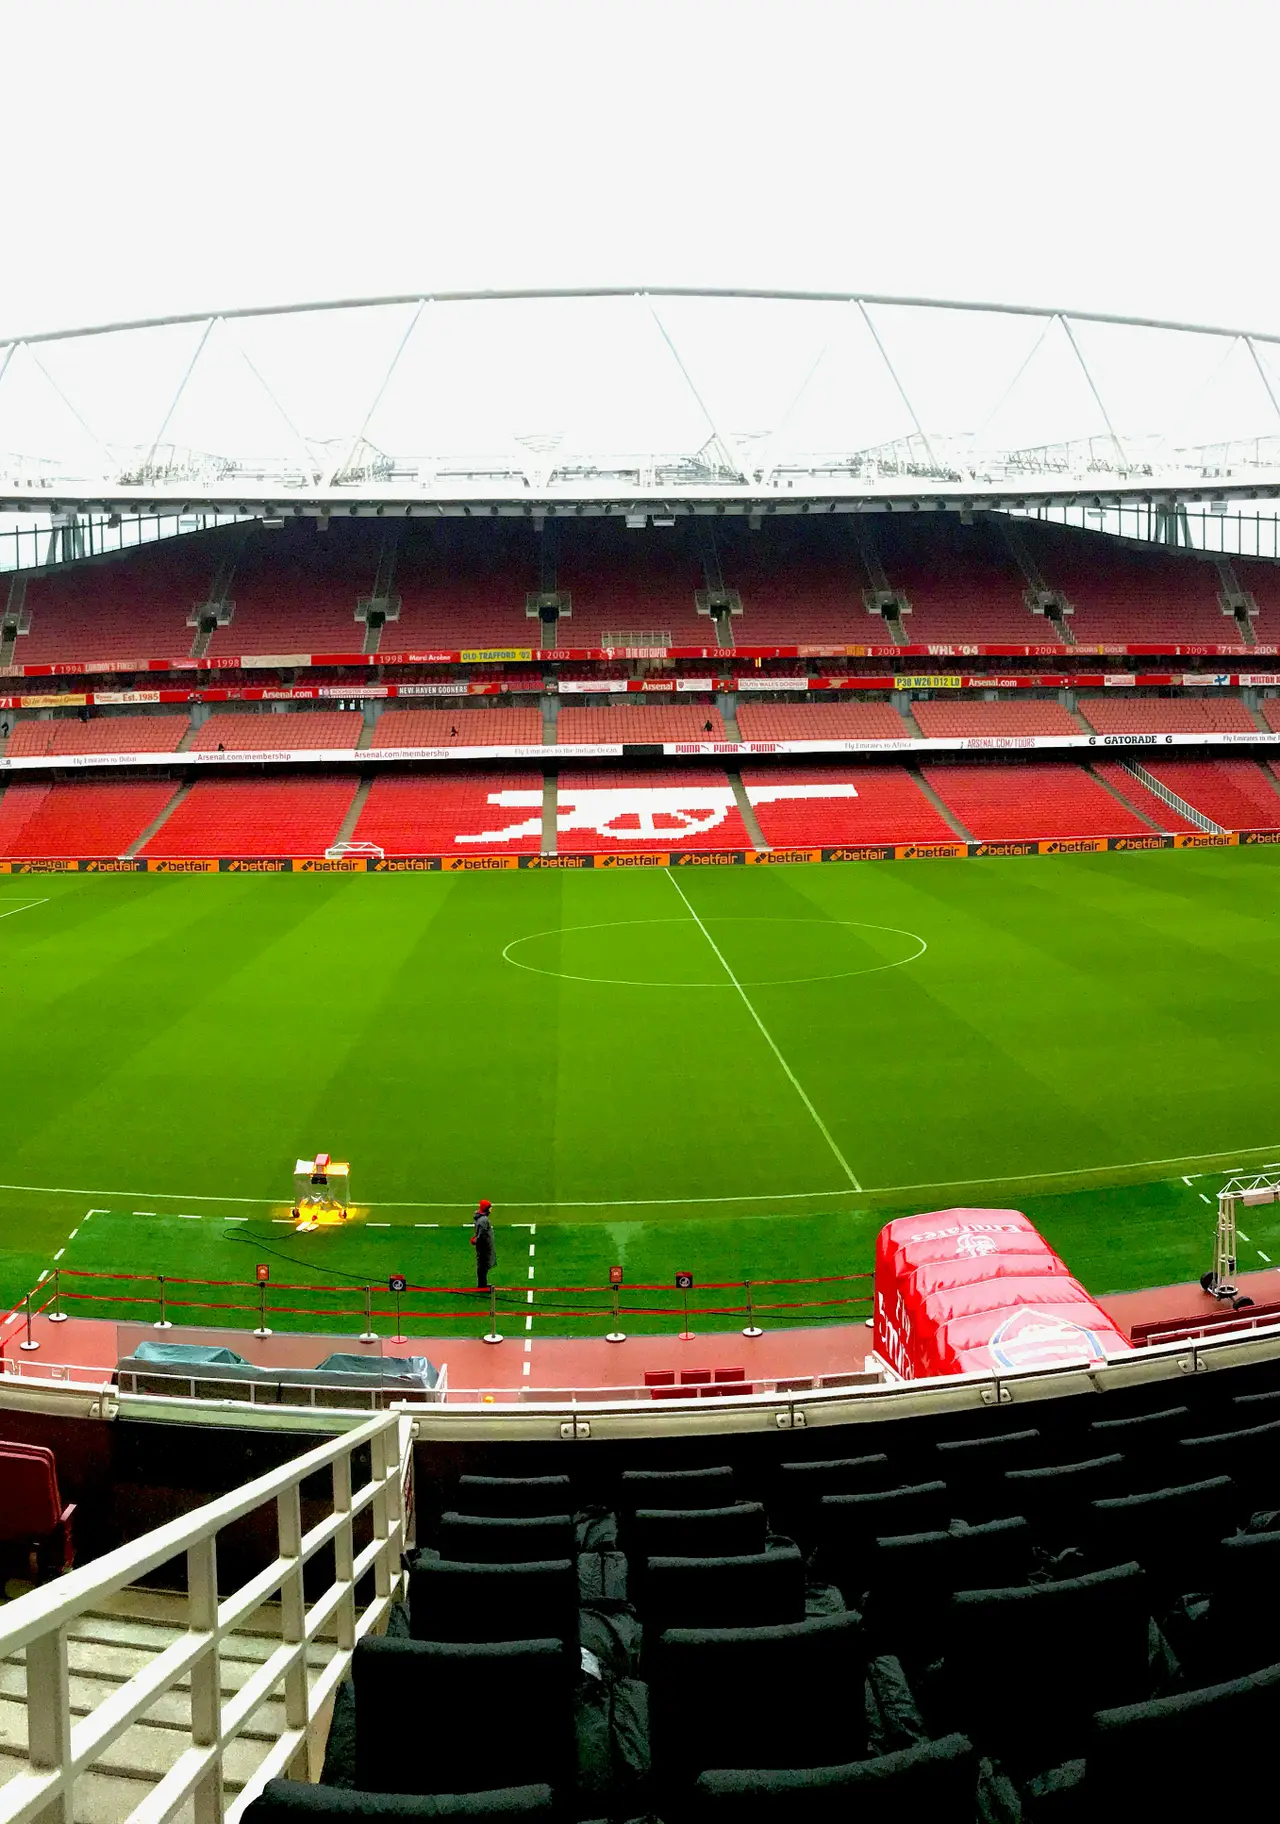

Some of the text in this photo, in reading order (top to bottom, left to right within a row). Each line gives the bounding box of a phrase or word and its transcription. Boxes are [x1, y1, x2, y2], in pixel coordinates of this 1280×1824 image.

[547, 651, 570, 659] 2002
[713, 648, 737, 657] 2002
[878, 647, 901, 655] 2003
[928, 645, 955, 655] WHL
[1186, 646, 1208, 655] 2005
[379, 655, 403, 664] 1998
[463, 651, 476, 661] OLD
[479, 650, 516, 660] TRAFFORD
[217, 658, 240, 668] 1998
[61, 664, 82, 674] 1994
[897, 677, 912, 687] P38
[914, 677, 931, 686] W26
[933, 677, 948, 686] D12
[968, 678, 1017, 687] Arsenal.com
[1250, 676, 1275, 684] MILTON
[412, 686, 436, 694] HAVEN
[438, 685, 468, 693] GOONERS
[642, 681, 673, 690] Arsenal
[122, 694, 137, 702] Est.
[139, 692, 158, 701] 1985
[262, 690, 313, 699] Arsenal.com
[0, 697, 13, 707] 71
[1089, 737, 1096, 745] G
[1104, 735, 1157, 744] GATORADE
[1165, 735, 1172, 743] G
[675, 744, 700, 753] PUMA
[713, 743, 738, 752] PUMA
[750, 743, 776, 752] PUMA
[198, 752, 291, 761] Arsenal.com/membership
[354, 749, 450, 759] Arsenal.com/membership
[1126, 838, 1167, 849] betfair
[1194, 836, 1233, 846] betfair
[986, 844, 1031, 856] betfair
[1059, 842, 1102, 852] betfair
[768, 852, 813, 863] betfair
[843, 849, 887, 860] betfair
[916, 847, 960, 858] betfair
[464, 858, 509, 869] betfair
[540, 857, 585, 867] betfair
[616, 855, 661, 866] betfair
[692, 854, 737, 864] betfair
[98, 861, 139, 871] betfair
[168, 861, 211, 871] betfair
[241, 860, 284, 871] betfair
[314, 861, 358, 870] betfair
[388, 859, 434, 870] betfair
